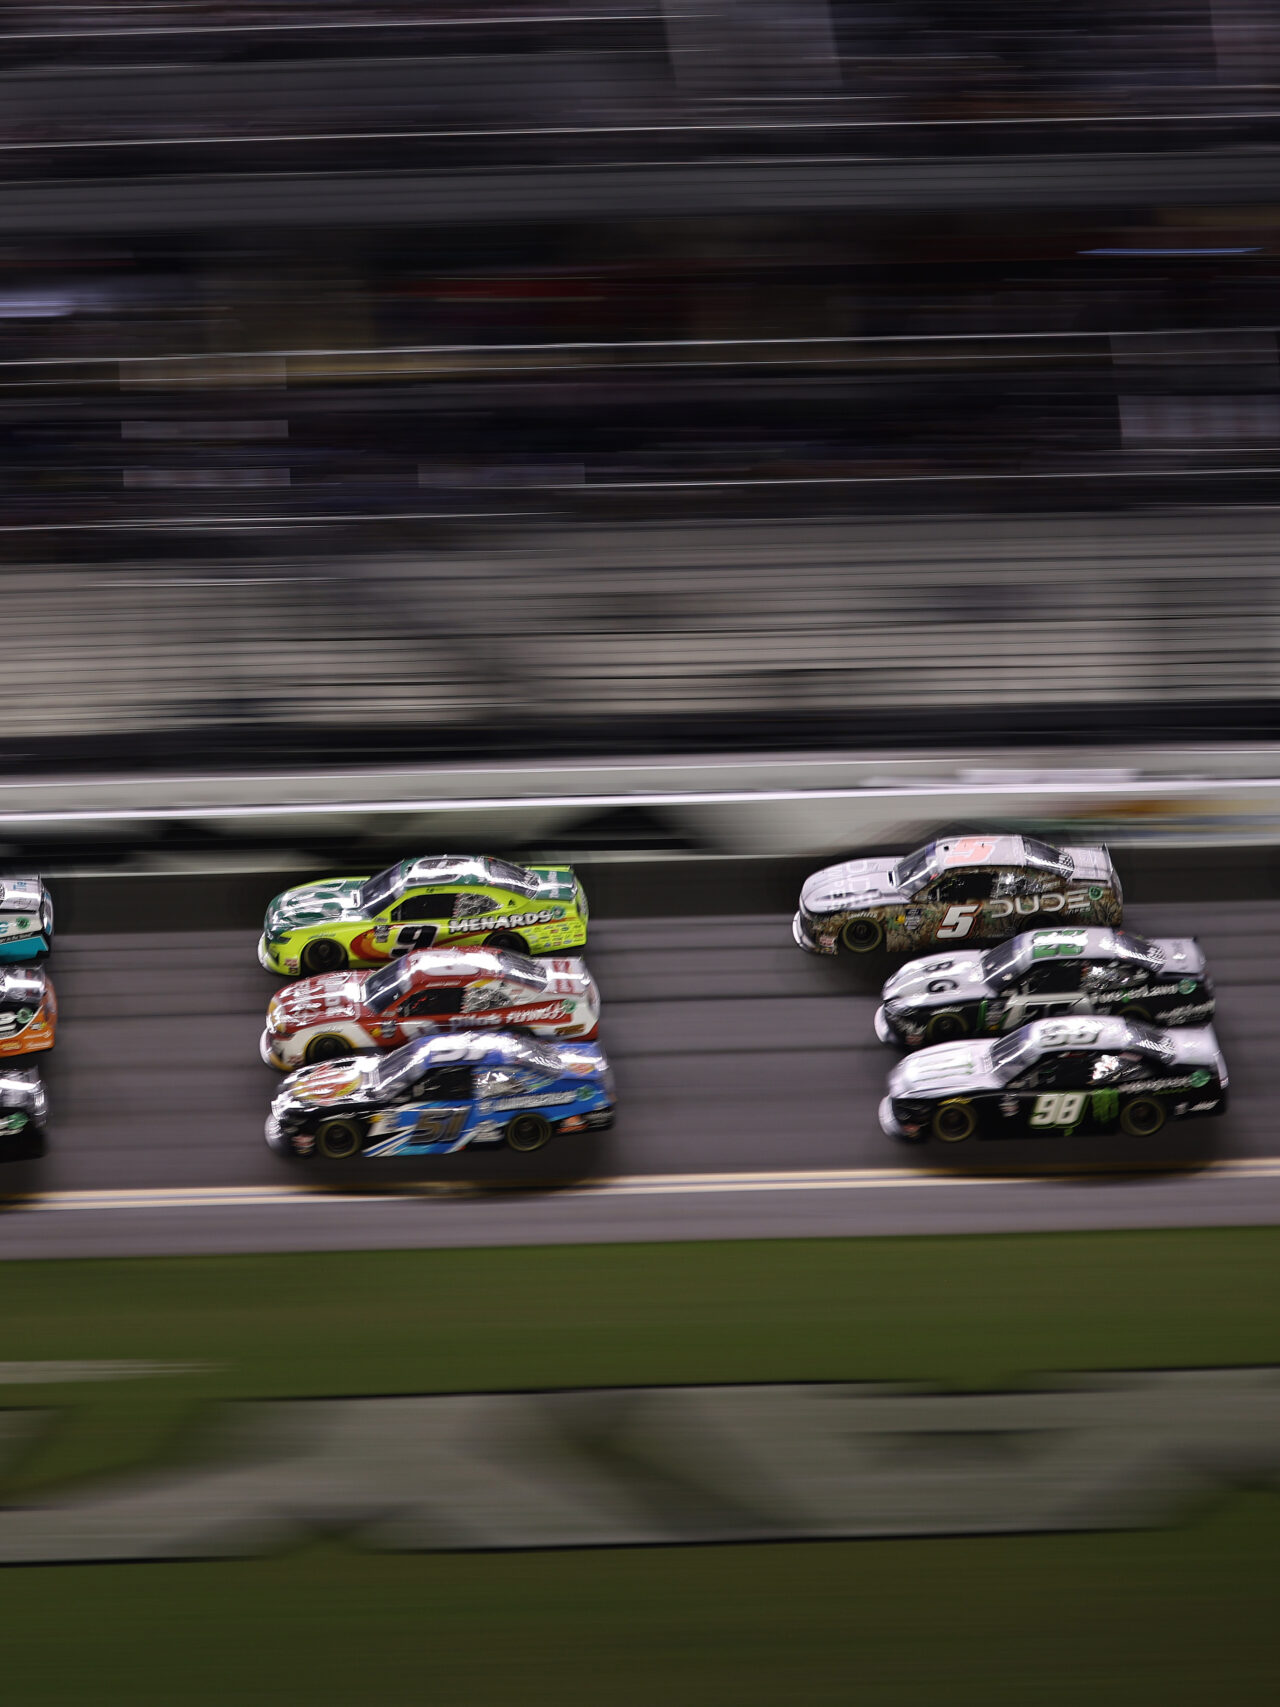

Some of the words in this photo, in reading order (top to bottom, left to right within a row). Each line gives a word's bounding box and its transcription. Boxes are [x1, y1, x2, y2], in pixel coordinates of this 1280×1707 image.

[943, 837, 997, 865] 5
[989, 888, 1090, 919] DUDE
[448, 909, 553, 935] MENARDS
[937, 904, 982, 939] 5
[390, 924, 439, 958] 9
[409, 1108, 472, 1144] 51
[1030, 1094, 1088, 1126] 98
